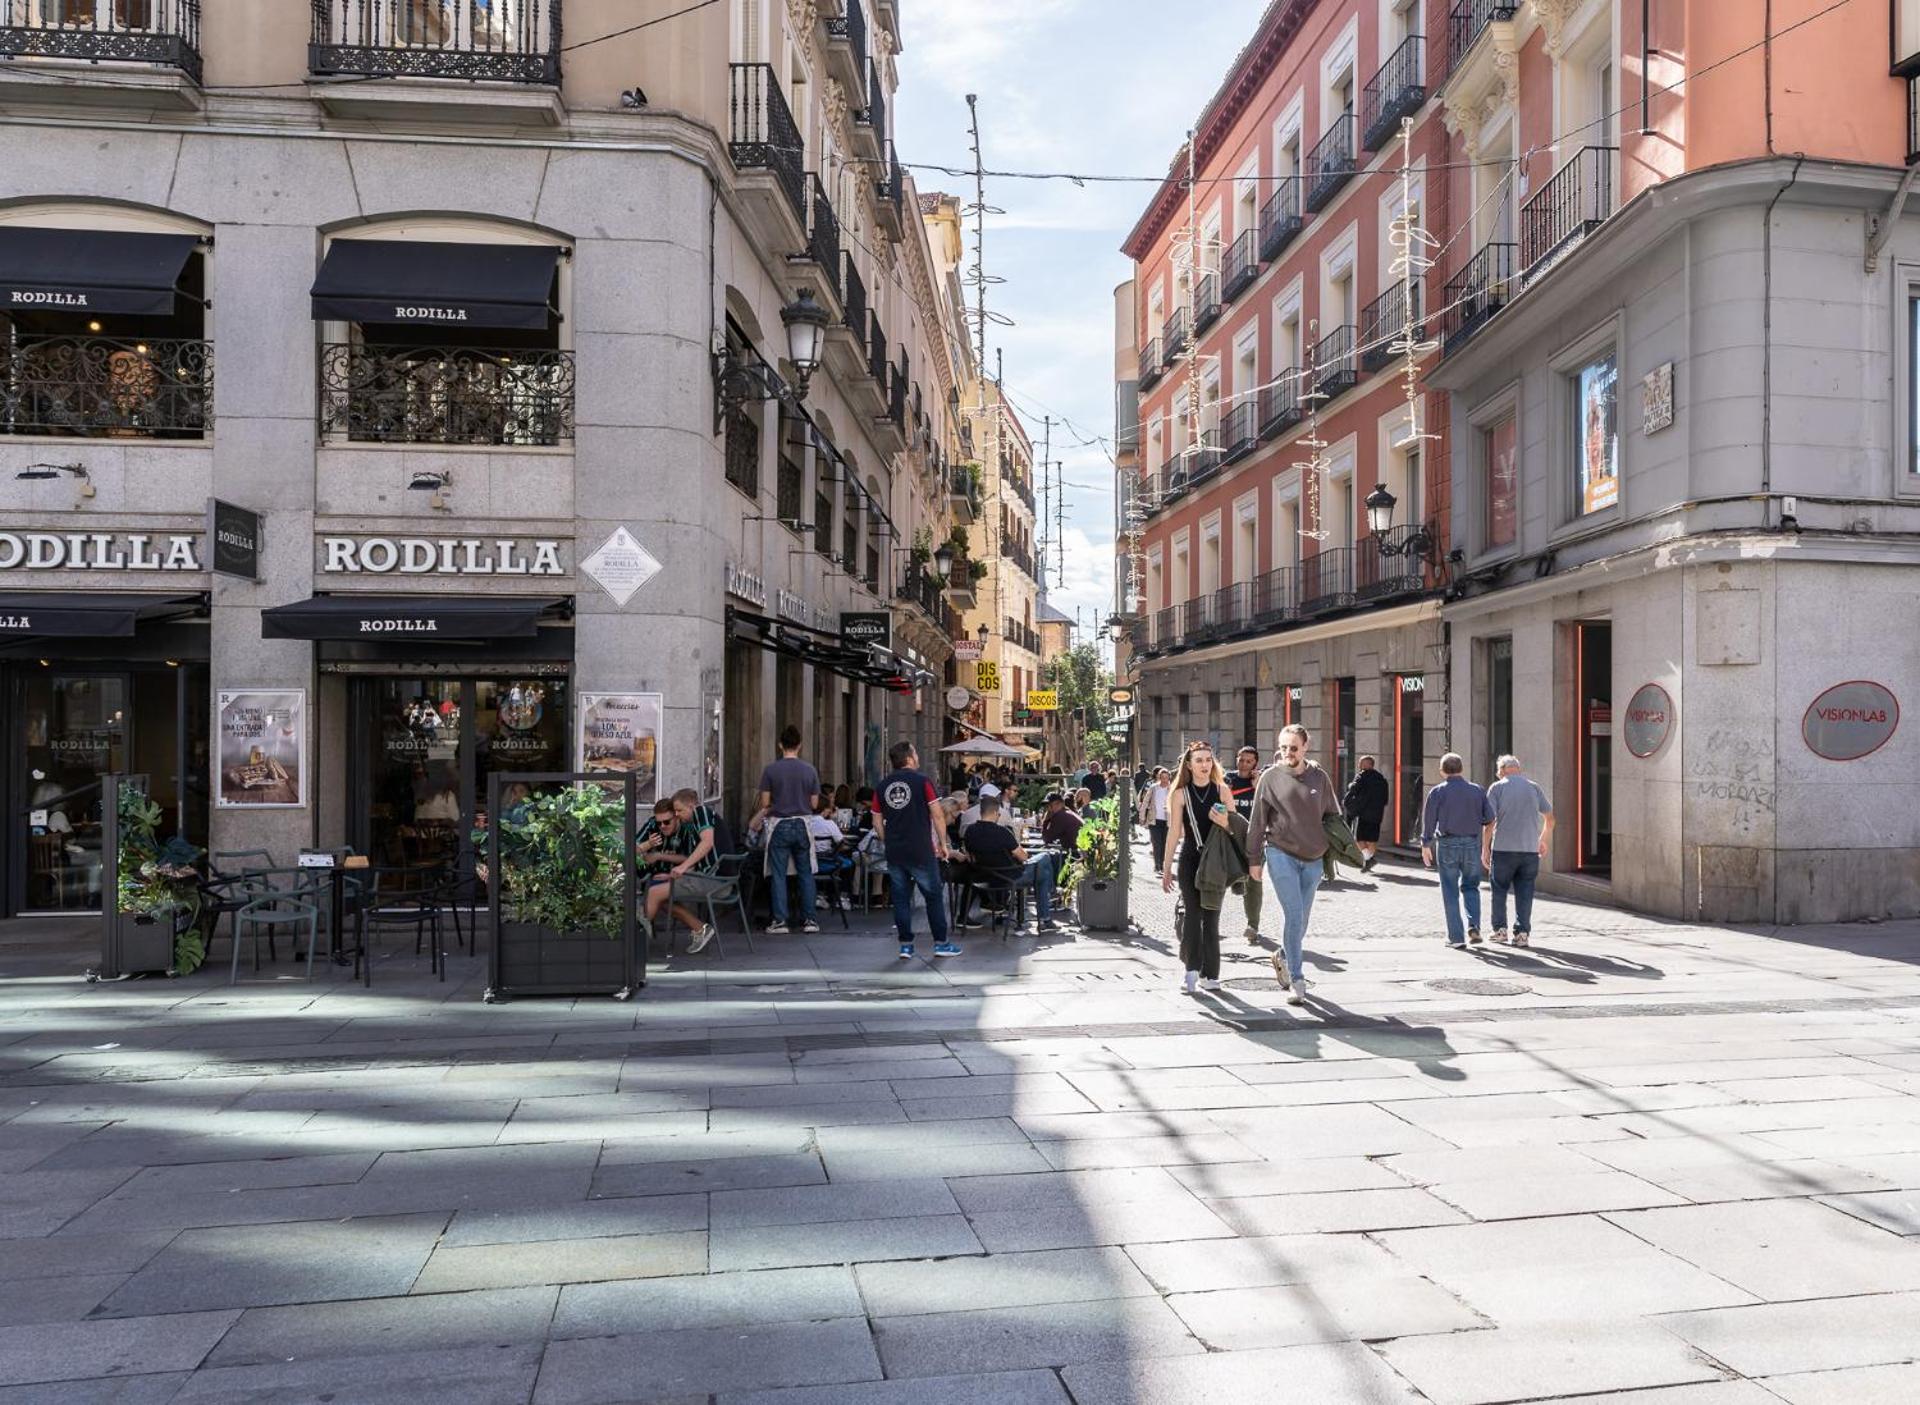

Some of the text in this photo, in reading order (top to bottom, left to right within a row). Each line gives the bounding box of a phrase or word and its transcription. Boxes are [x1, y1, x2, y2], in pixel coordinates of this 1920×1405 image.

[11, 291, 88, 306] RODILLA
[396, 306, 467, 320] RODILLA
[218, 529, 253, 550] RODILLA
[0, 533, 200, 571] ODILLA
[324, 537, 565, 576] RODILLA
[360, 620, 438, 633] RODILLA
[844, 626, 886, 634] RODILLA
[977, 662, 996, 675] DIS
[977, 676, 1000, 690] COS
[221, 694, 230, 703] R
[1028, 694, 1057, 707] DISCOS
[1816, 707, 1888, 723] VISIONLAB
[50, 740, 110, 751] RODILLA
[492, 739, 549, 751] RODILLA
